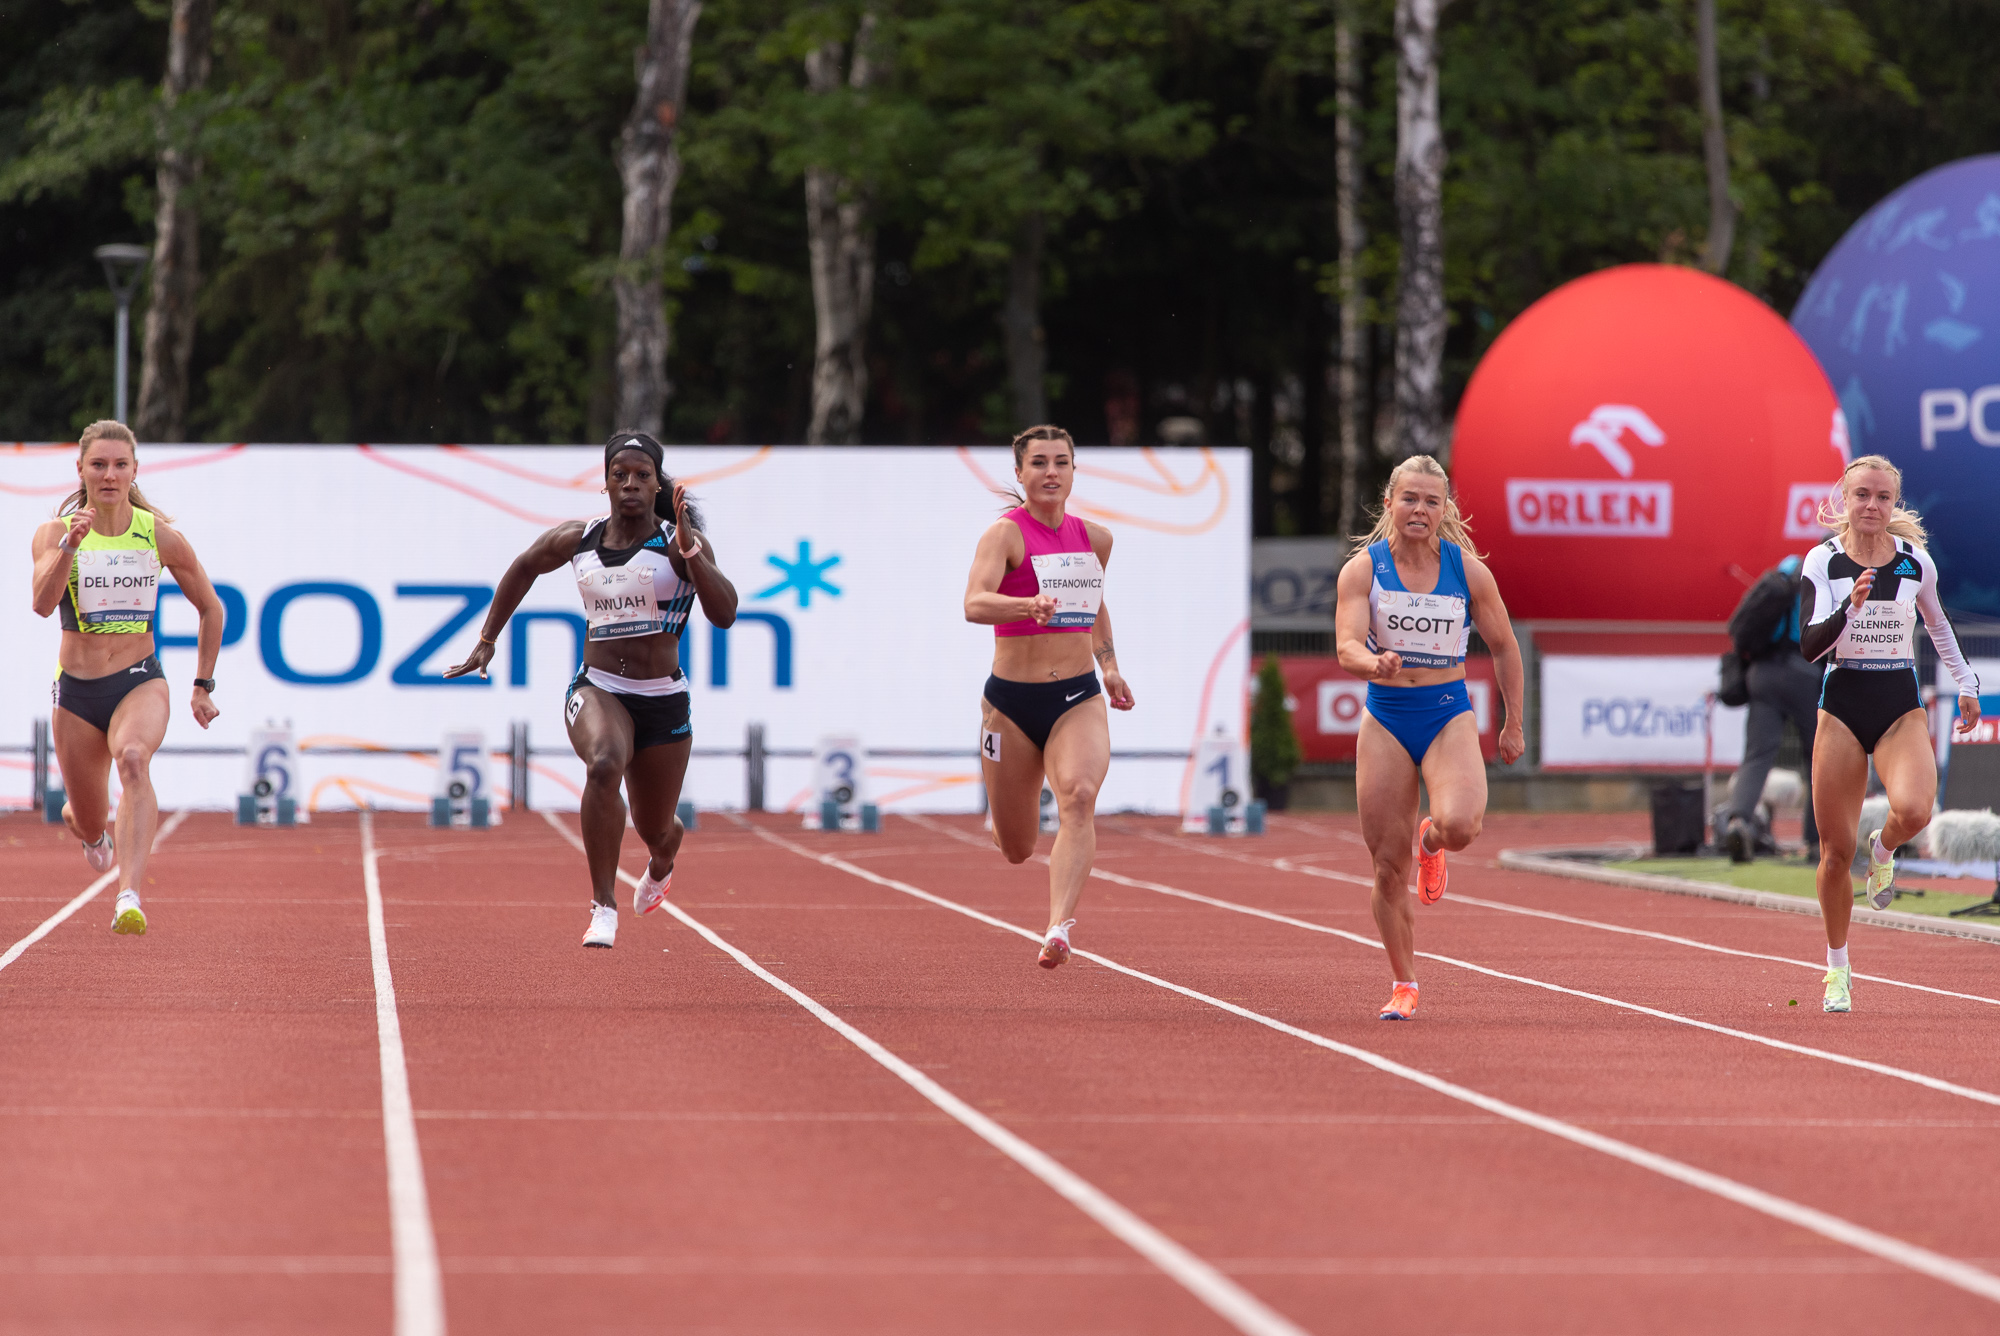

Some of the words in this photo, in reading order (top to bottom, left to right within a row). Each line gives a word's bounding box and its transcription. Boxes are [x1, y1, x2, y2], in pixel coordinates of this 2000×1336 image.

[1519, 491, 1656, 523] ORLEN
[1893, 568, 1917, 576] adidas
[84, 576, 110, 588] DEL
[113, 575, 155, 588] PONTE
[1042, 578, 1102, 589] STEFANOWICZ
[594, 595, 646, 611] AWUAH
[105, 612, 134, 621] POZNAŃ
[1060, 615, 1083, 624] POZNAŃ
[609, 626, 634, 634] POZNAŃ
[634, 623, 649, 631] 2022
[1387, 614, 1455, 635] SCOTT
[1851, 620, 1904, 629] GLENNER-
[1850, 633, 1904, 643] FRANDSEN
[1402, 654, 1432, 664] POZNAŃ
[1862, 661, 1891, 669] POZNAŃ
[1891, 661, 1905, 669] 2022
[569, 699, 581, 718] 5
[984, 733, 996, 758] 4
[256, 745, 289, 798] 6
[451, 746, 481, 800] 5
[824, 751, 855, 802] 3
[1205, 754, 1229, 790] 1
